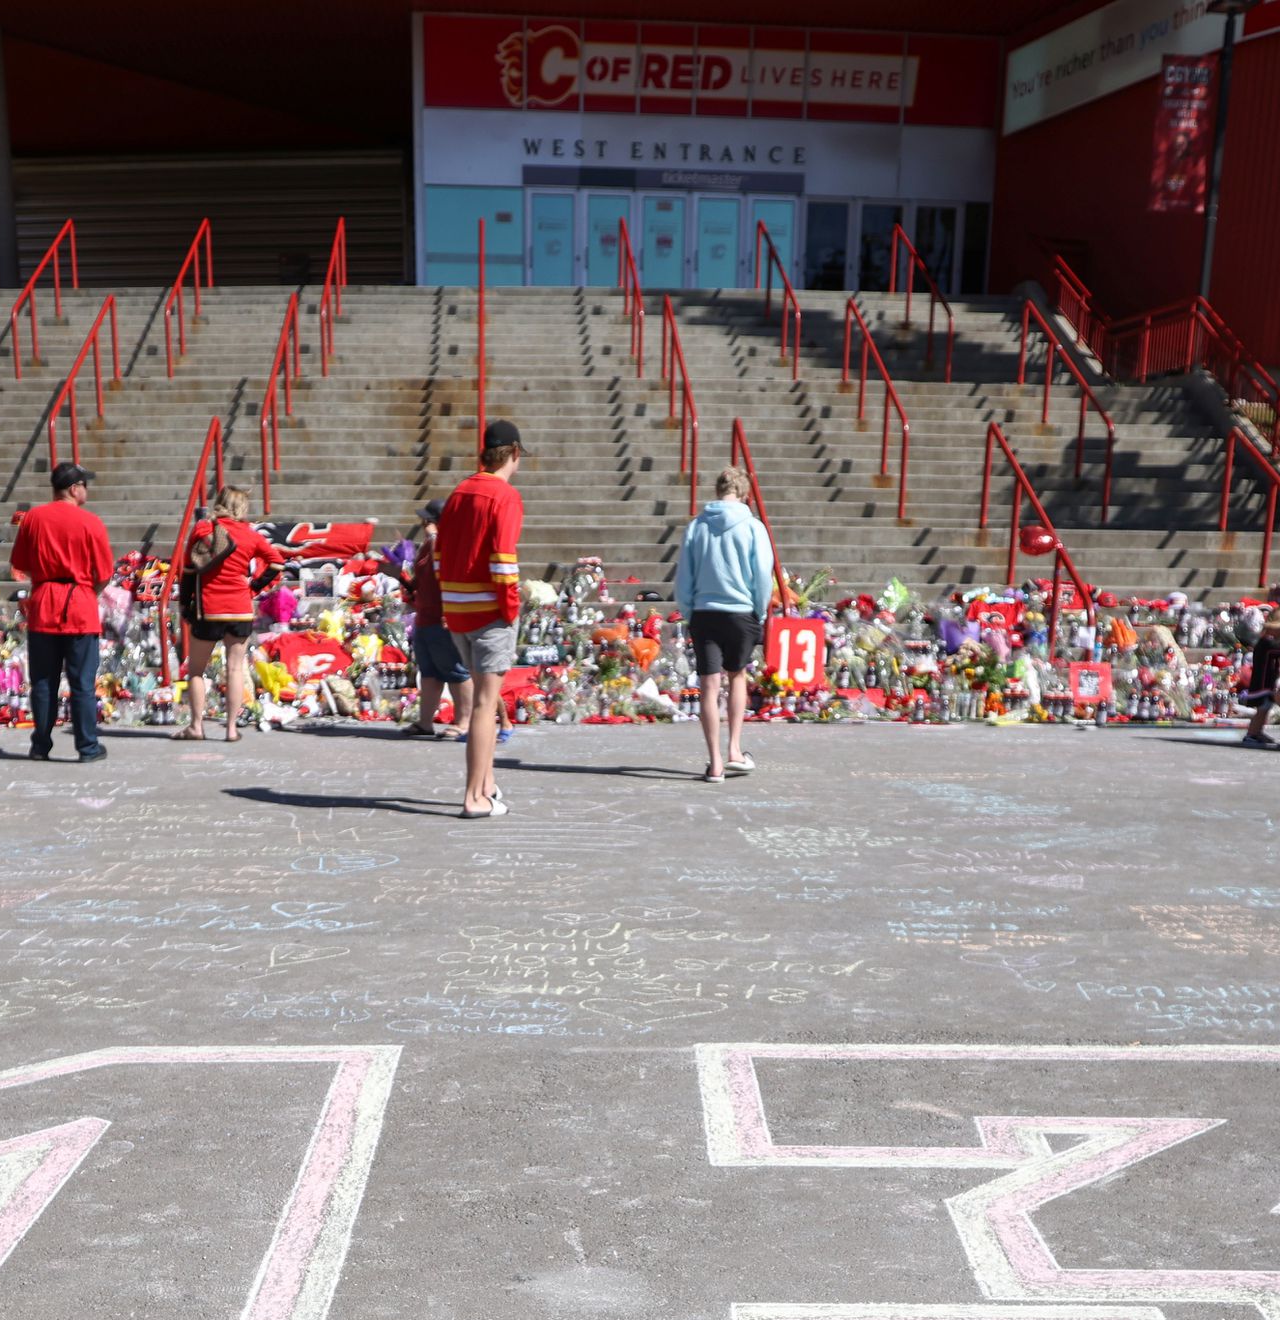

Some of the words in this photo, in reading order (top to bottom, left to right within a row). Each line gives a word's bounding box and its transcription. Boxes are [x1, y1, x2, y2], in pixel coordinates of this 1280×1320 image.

[1139, 18, 1171, 50] you
[586, 55, 632, 82] OF
[640, 53, 733, 90] RED
[741, 66, 822, 86] LIVES
[829, 67, 903, 91] HERE
[523, 138, 609, 159] WEST
[631, 141, 808, 165] ENTRANCE
[778, 628, 818, 684] 13
